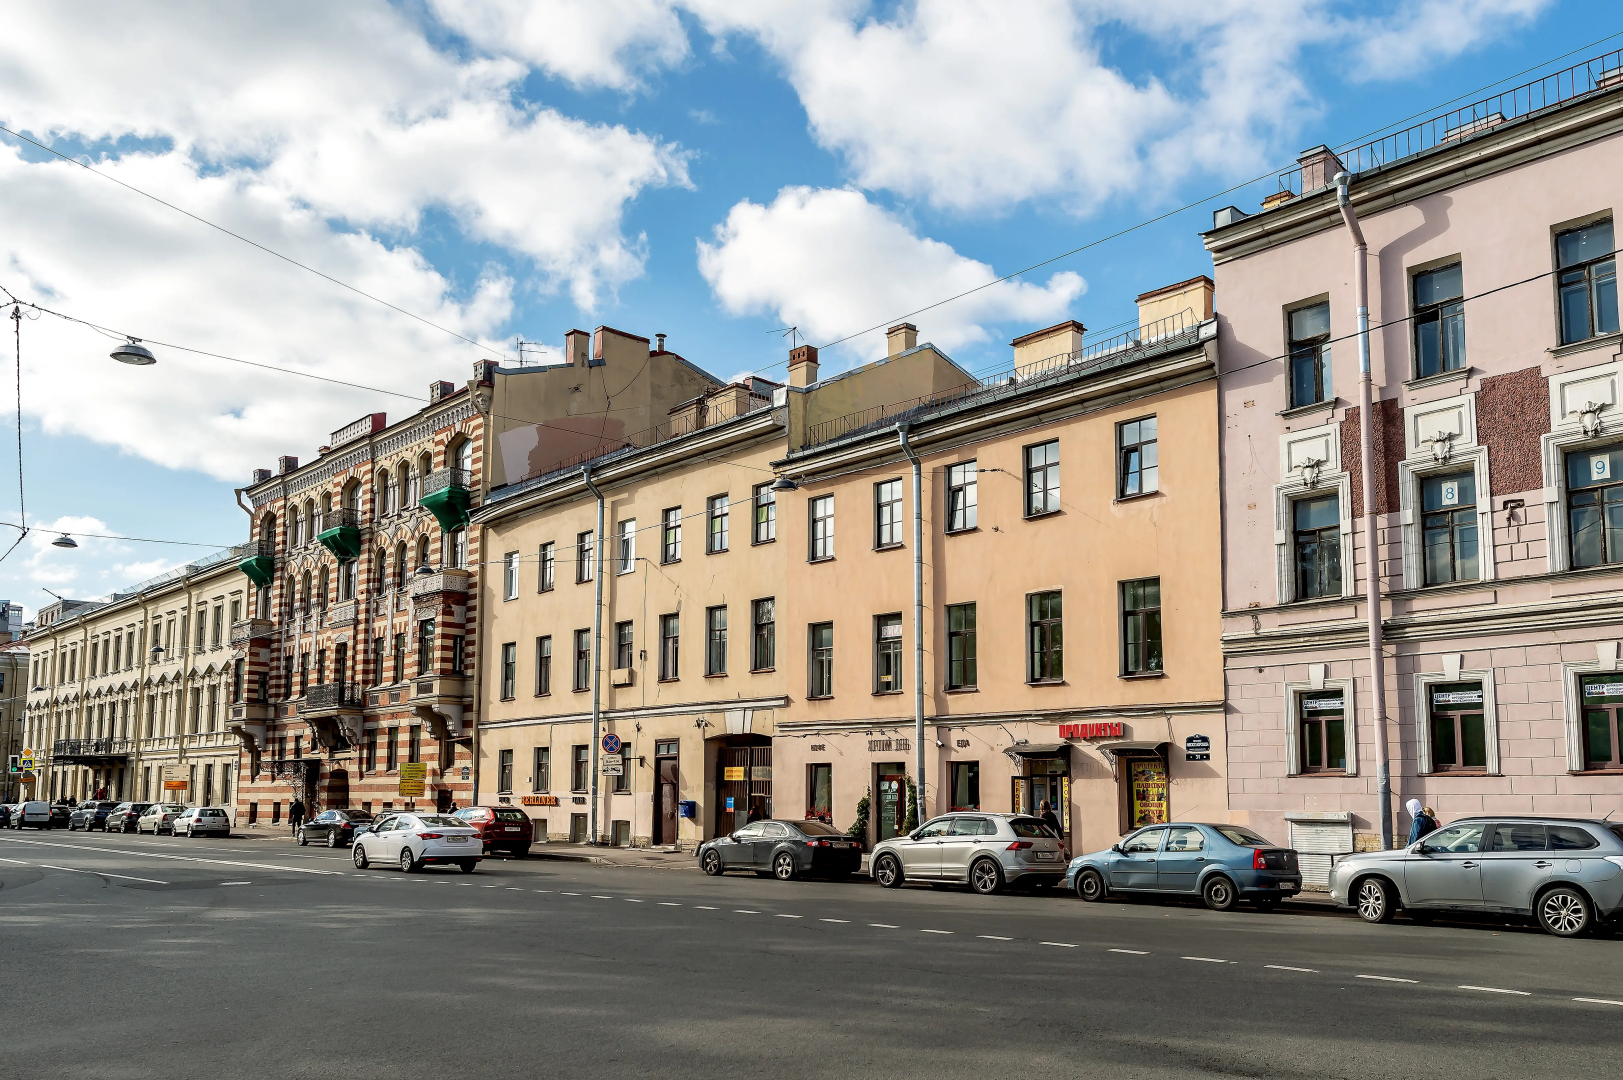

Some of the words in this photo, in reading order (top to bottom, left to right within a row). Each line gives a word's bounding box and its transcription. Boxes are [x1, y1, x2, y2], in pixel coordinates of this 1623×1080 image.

[1595, 460, 1606, 474] 9
[1445, 487, 1455, 500] 8
[1058, 722, 1122, 740] ПРОДУКТЫ
[956, 739, 970, 748] ЕДА
[521, 796, 556, 805] BERLINER
